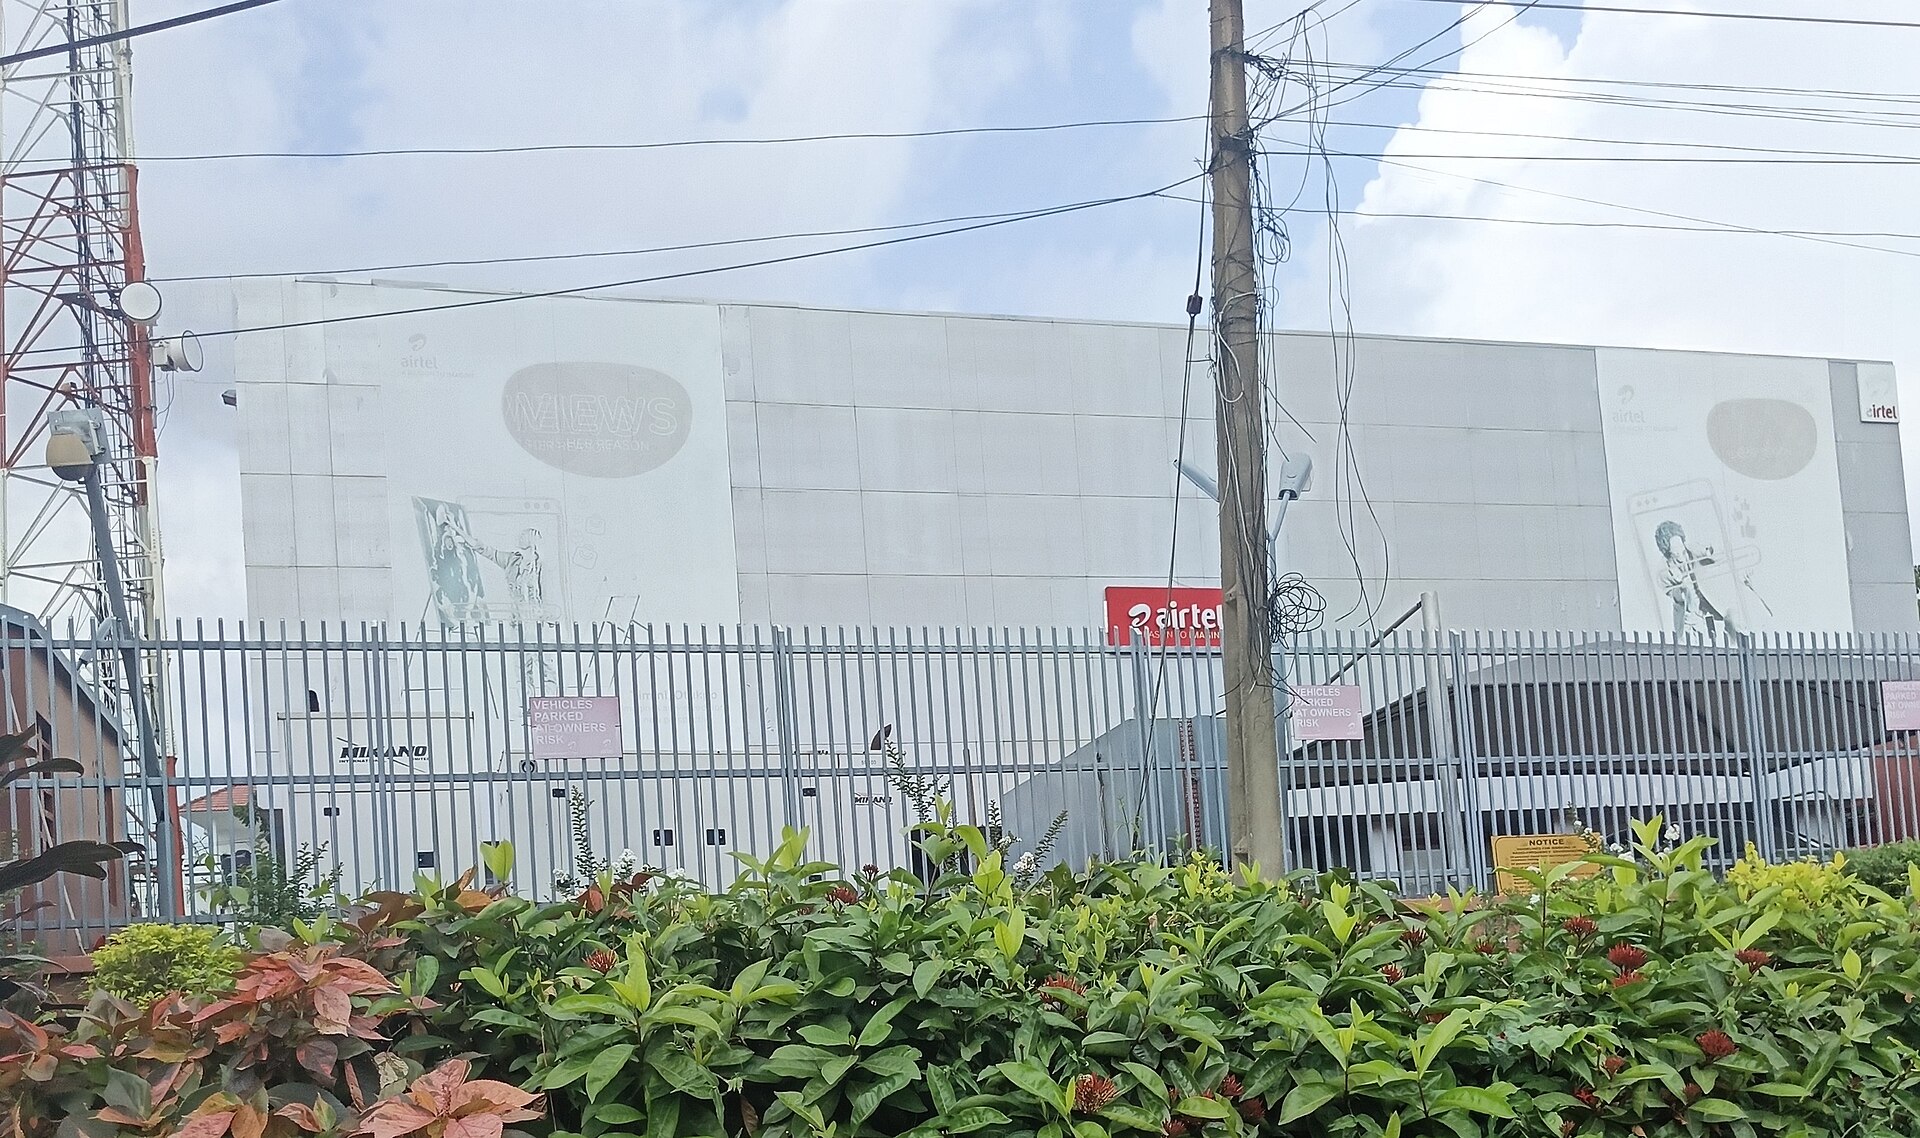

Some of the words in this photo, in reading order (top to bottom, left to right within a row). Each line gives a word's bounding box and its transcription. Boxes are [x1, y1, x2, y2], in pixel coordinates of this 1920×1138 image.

[401, 355, 439, 369] airtel
[1866, 404, 1897, 419] airtel
[1156, 601, 1223, 629] airtel
[1294, 688, 1341, 697] VEHICLES
[533, 700, 593, 710] VEHICLES
[1296, 698, 1333, 706] PARKED
[534, 711, 583, 722] PARKED
[1296, 708, 1307, 717] AT
[1310, 708, 1352, 717] OWNERS
[555, 722, 606, 733] OWNERS
[1298, 719, 1319, 727] RISK
[537, 735, 564, 745] RISK
